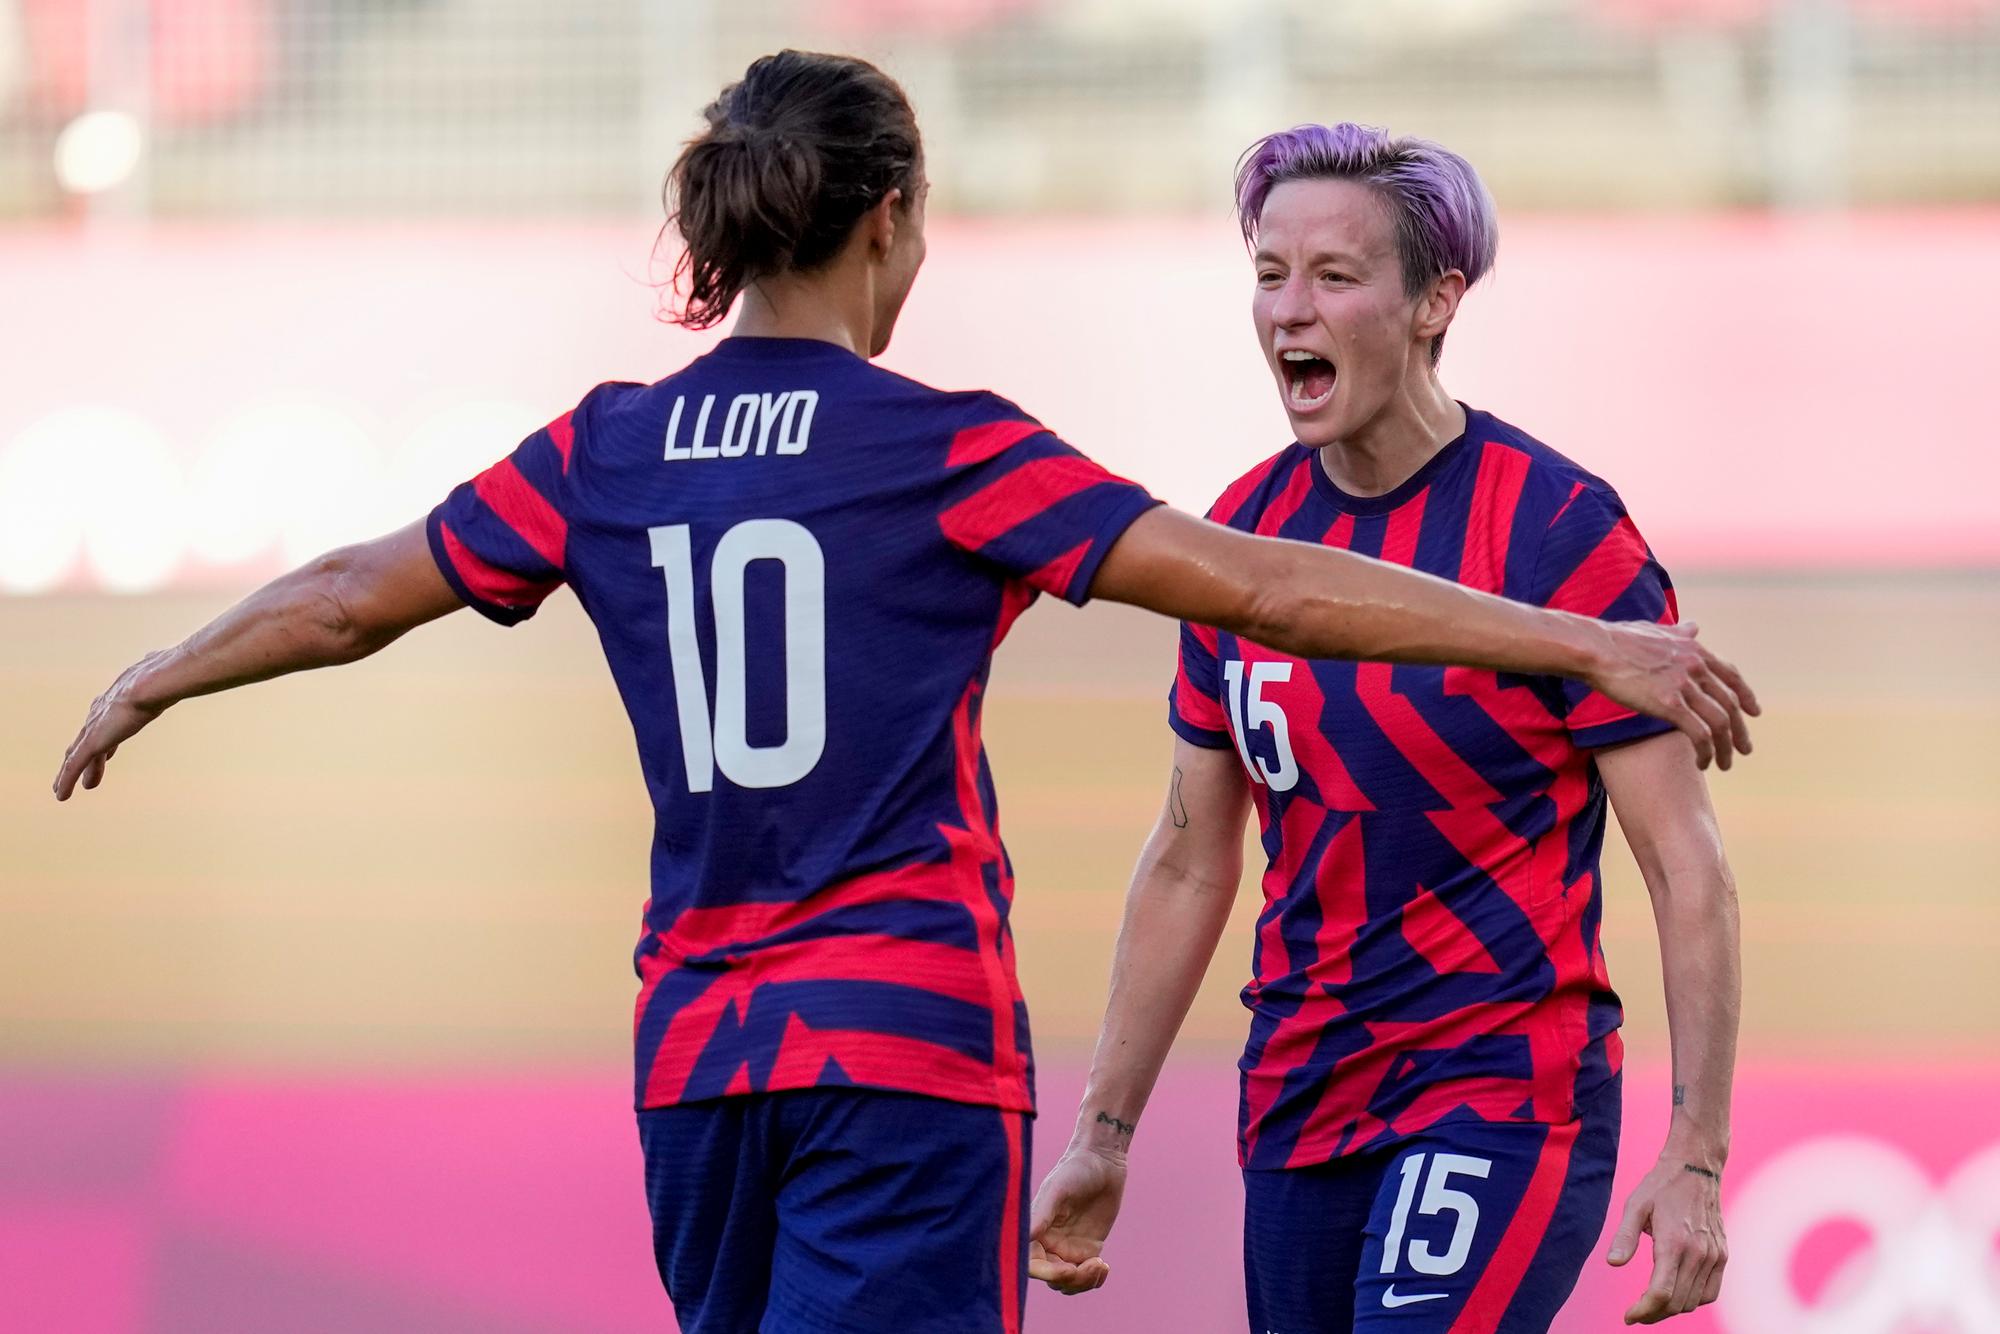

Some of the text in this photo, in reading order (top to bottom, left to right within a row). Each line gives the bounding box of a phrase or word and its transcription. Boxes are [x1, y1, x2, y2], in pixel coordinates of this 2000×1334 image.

[664, 390, 819, 461] LLOYD
[648, 518, 826, 793] 10
[1223, 660, 1299, 792] 15
[1379, 1152, 1492, 1276] 15
